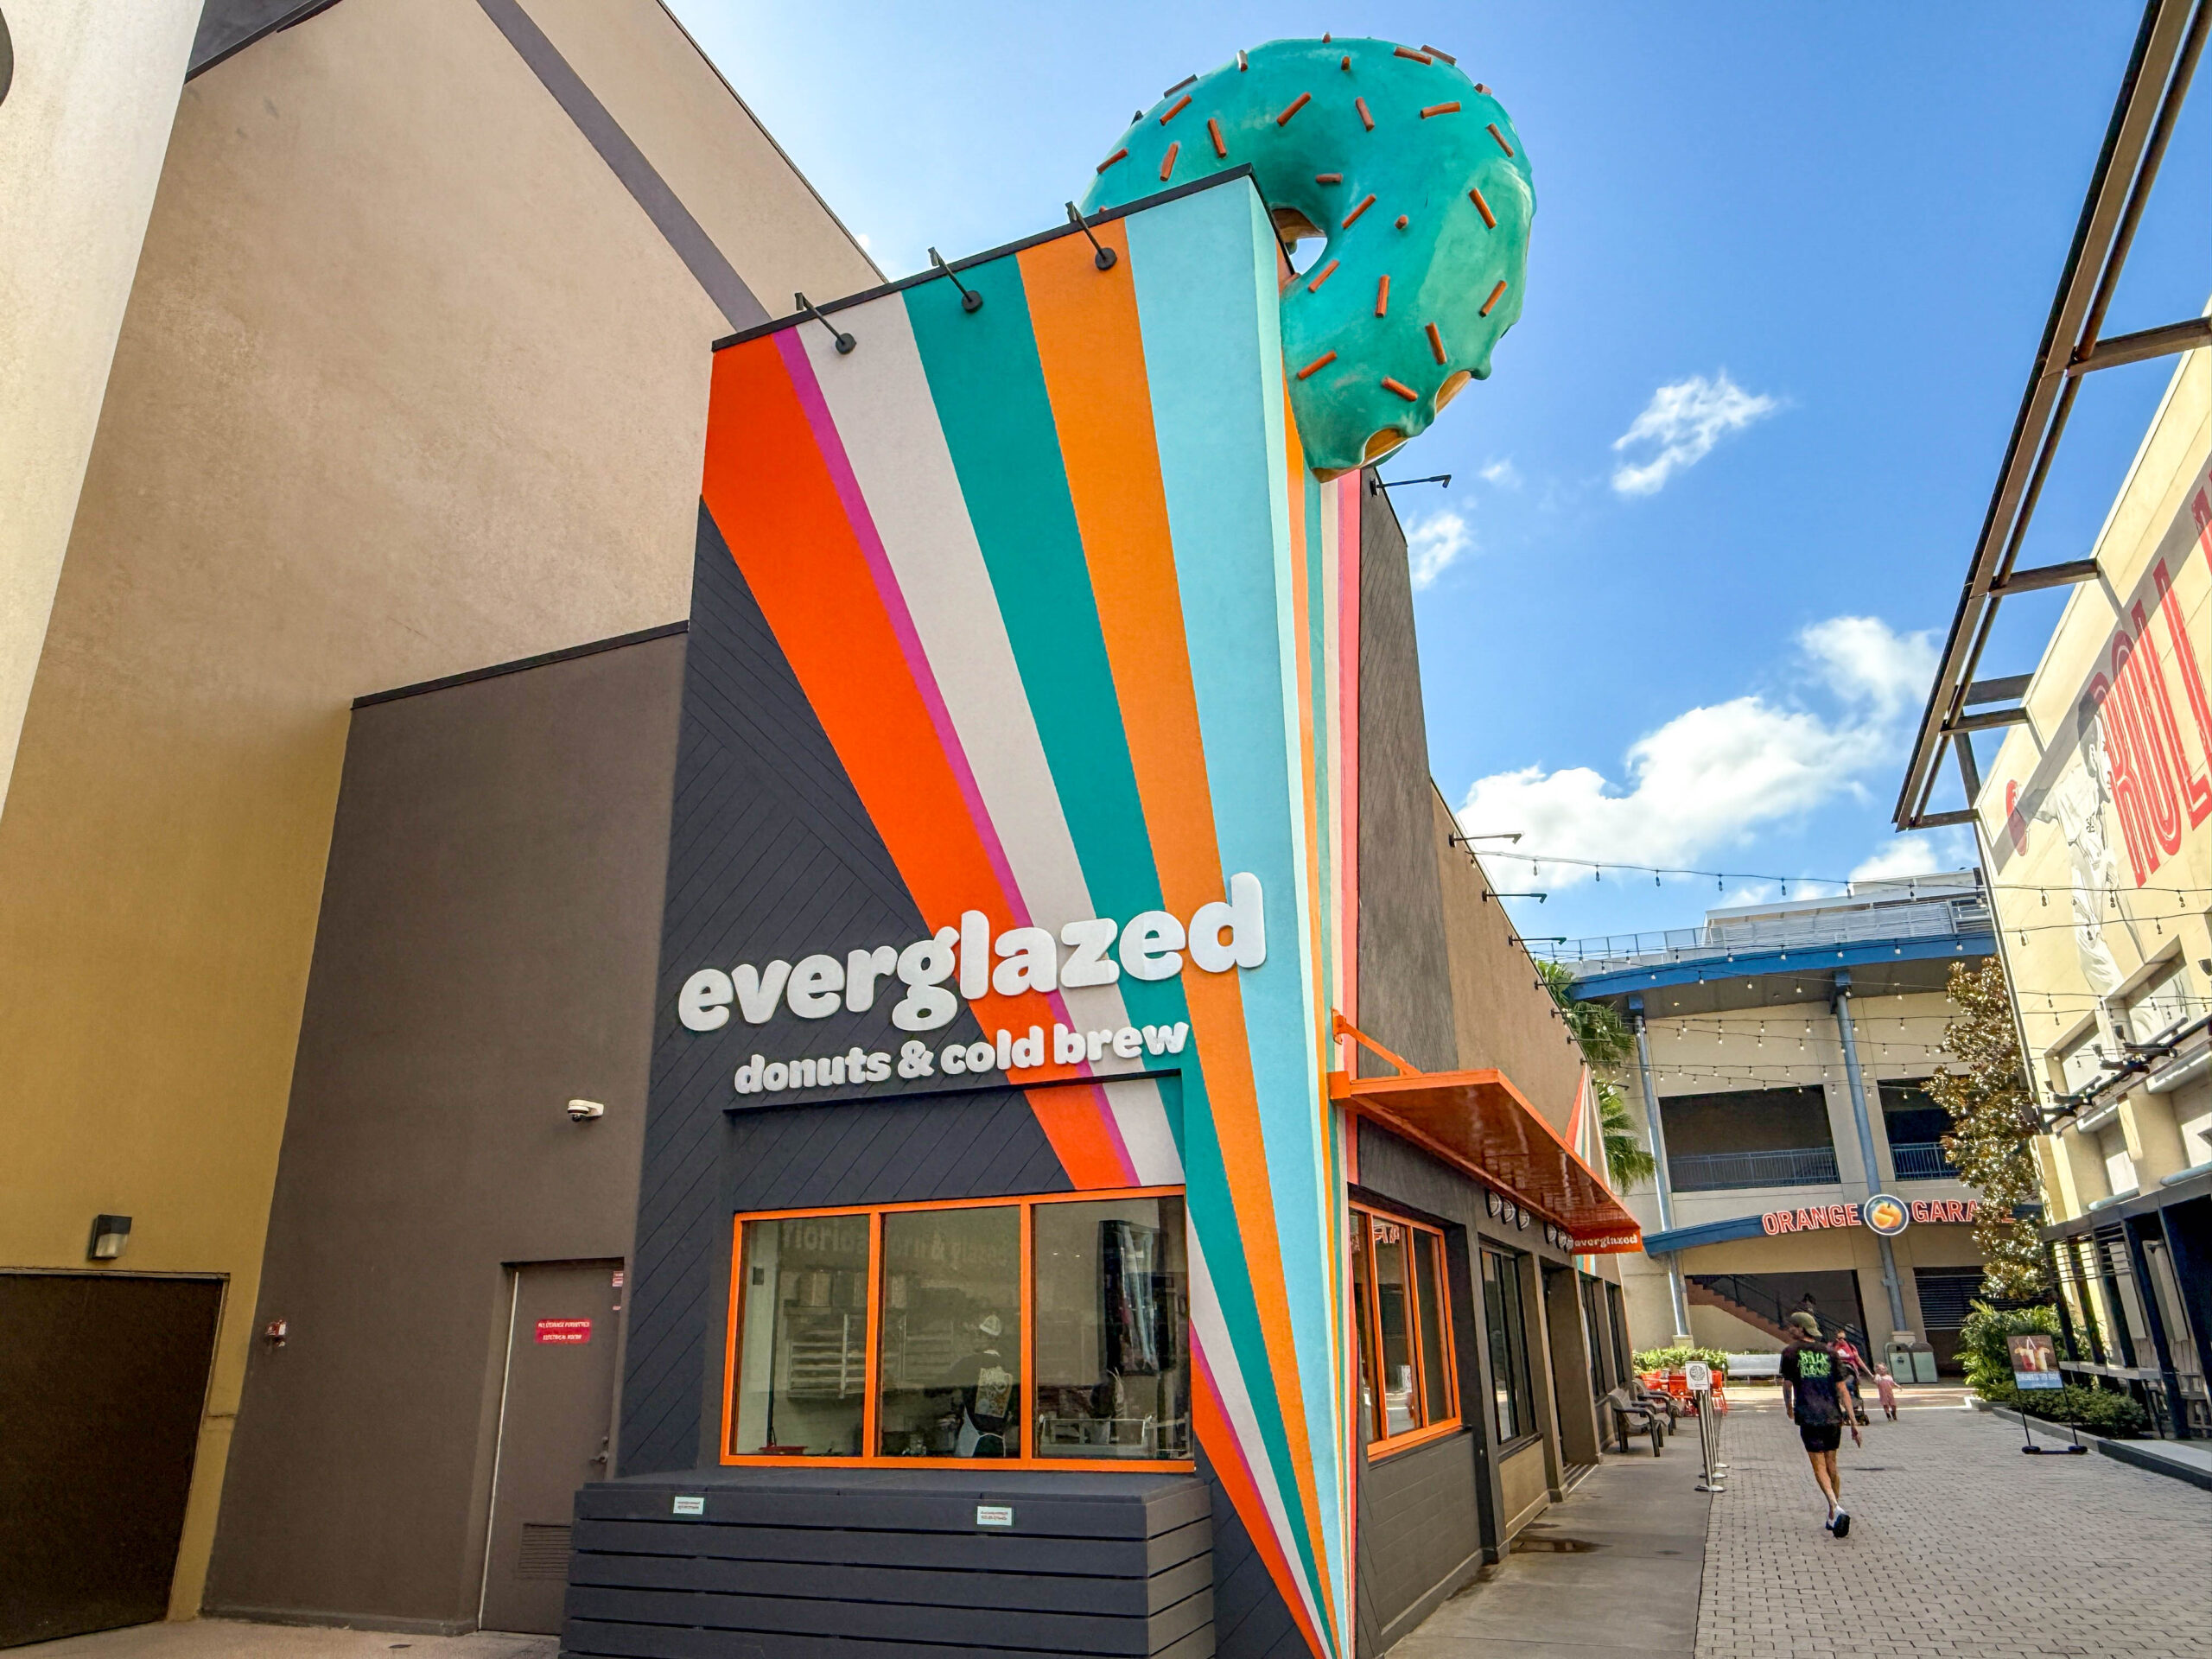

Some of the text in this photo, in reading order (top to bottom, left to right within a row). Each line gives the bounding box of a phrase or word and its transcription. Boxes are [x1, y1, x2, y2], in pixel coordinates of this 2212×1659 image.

[678, 872, 1267, 1031] everglazed
[734, 1022, 1189, 1094] donuts & cold brew
[1761, 1204, 1862, 1236] ORANGE
